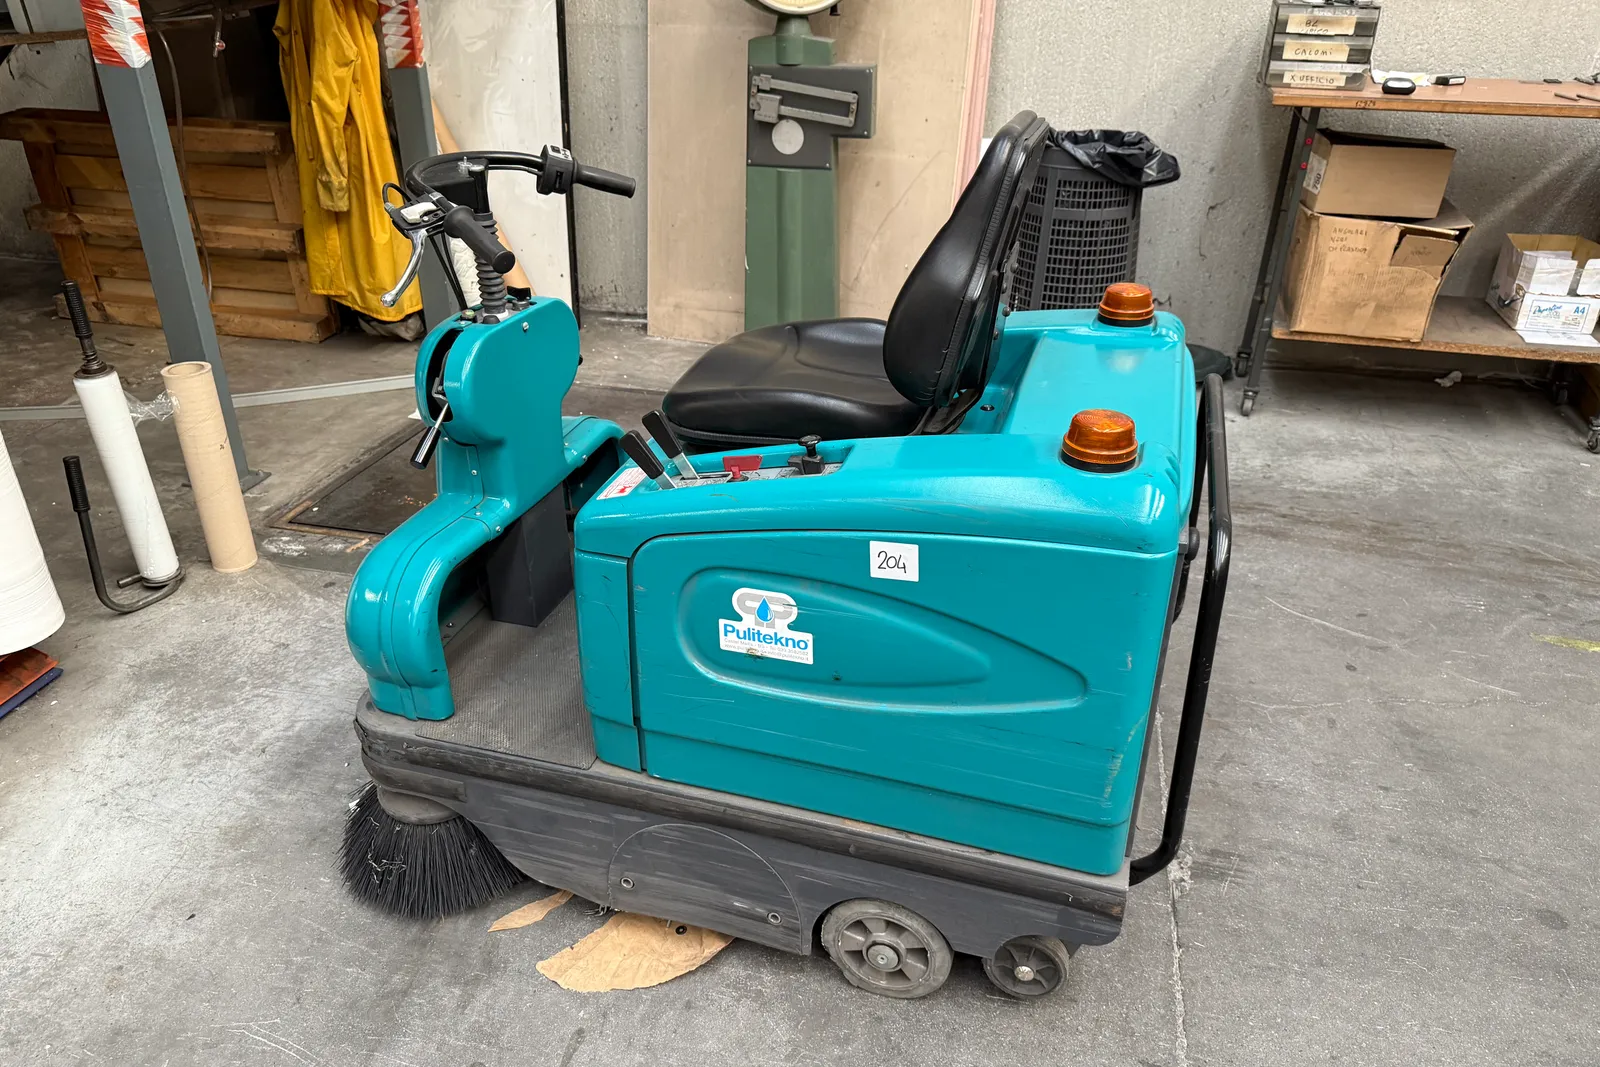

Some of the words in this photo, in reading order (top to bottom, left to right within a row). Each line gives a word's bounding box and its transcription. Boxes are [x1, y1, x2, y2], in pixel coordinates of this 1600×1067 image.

[1290, 74, 1296, 82] X
[1299, 75, 1335, 84] UFFICIO
[1573, 305, 1586, 315] A4
[877, 550, 907, 574] 204
[723, 623, 809, 651] Pulitekno
